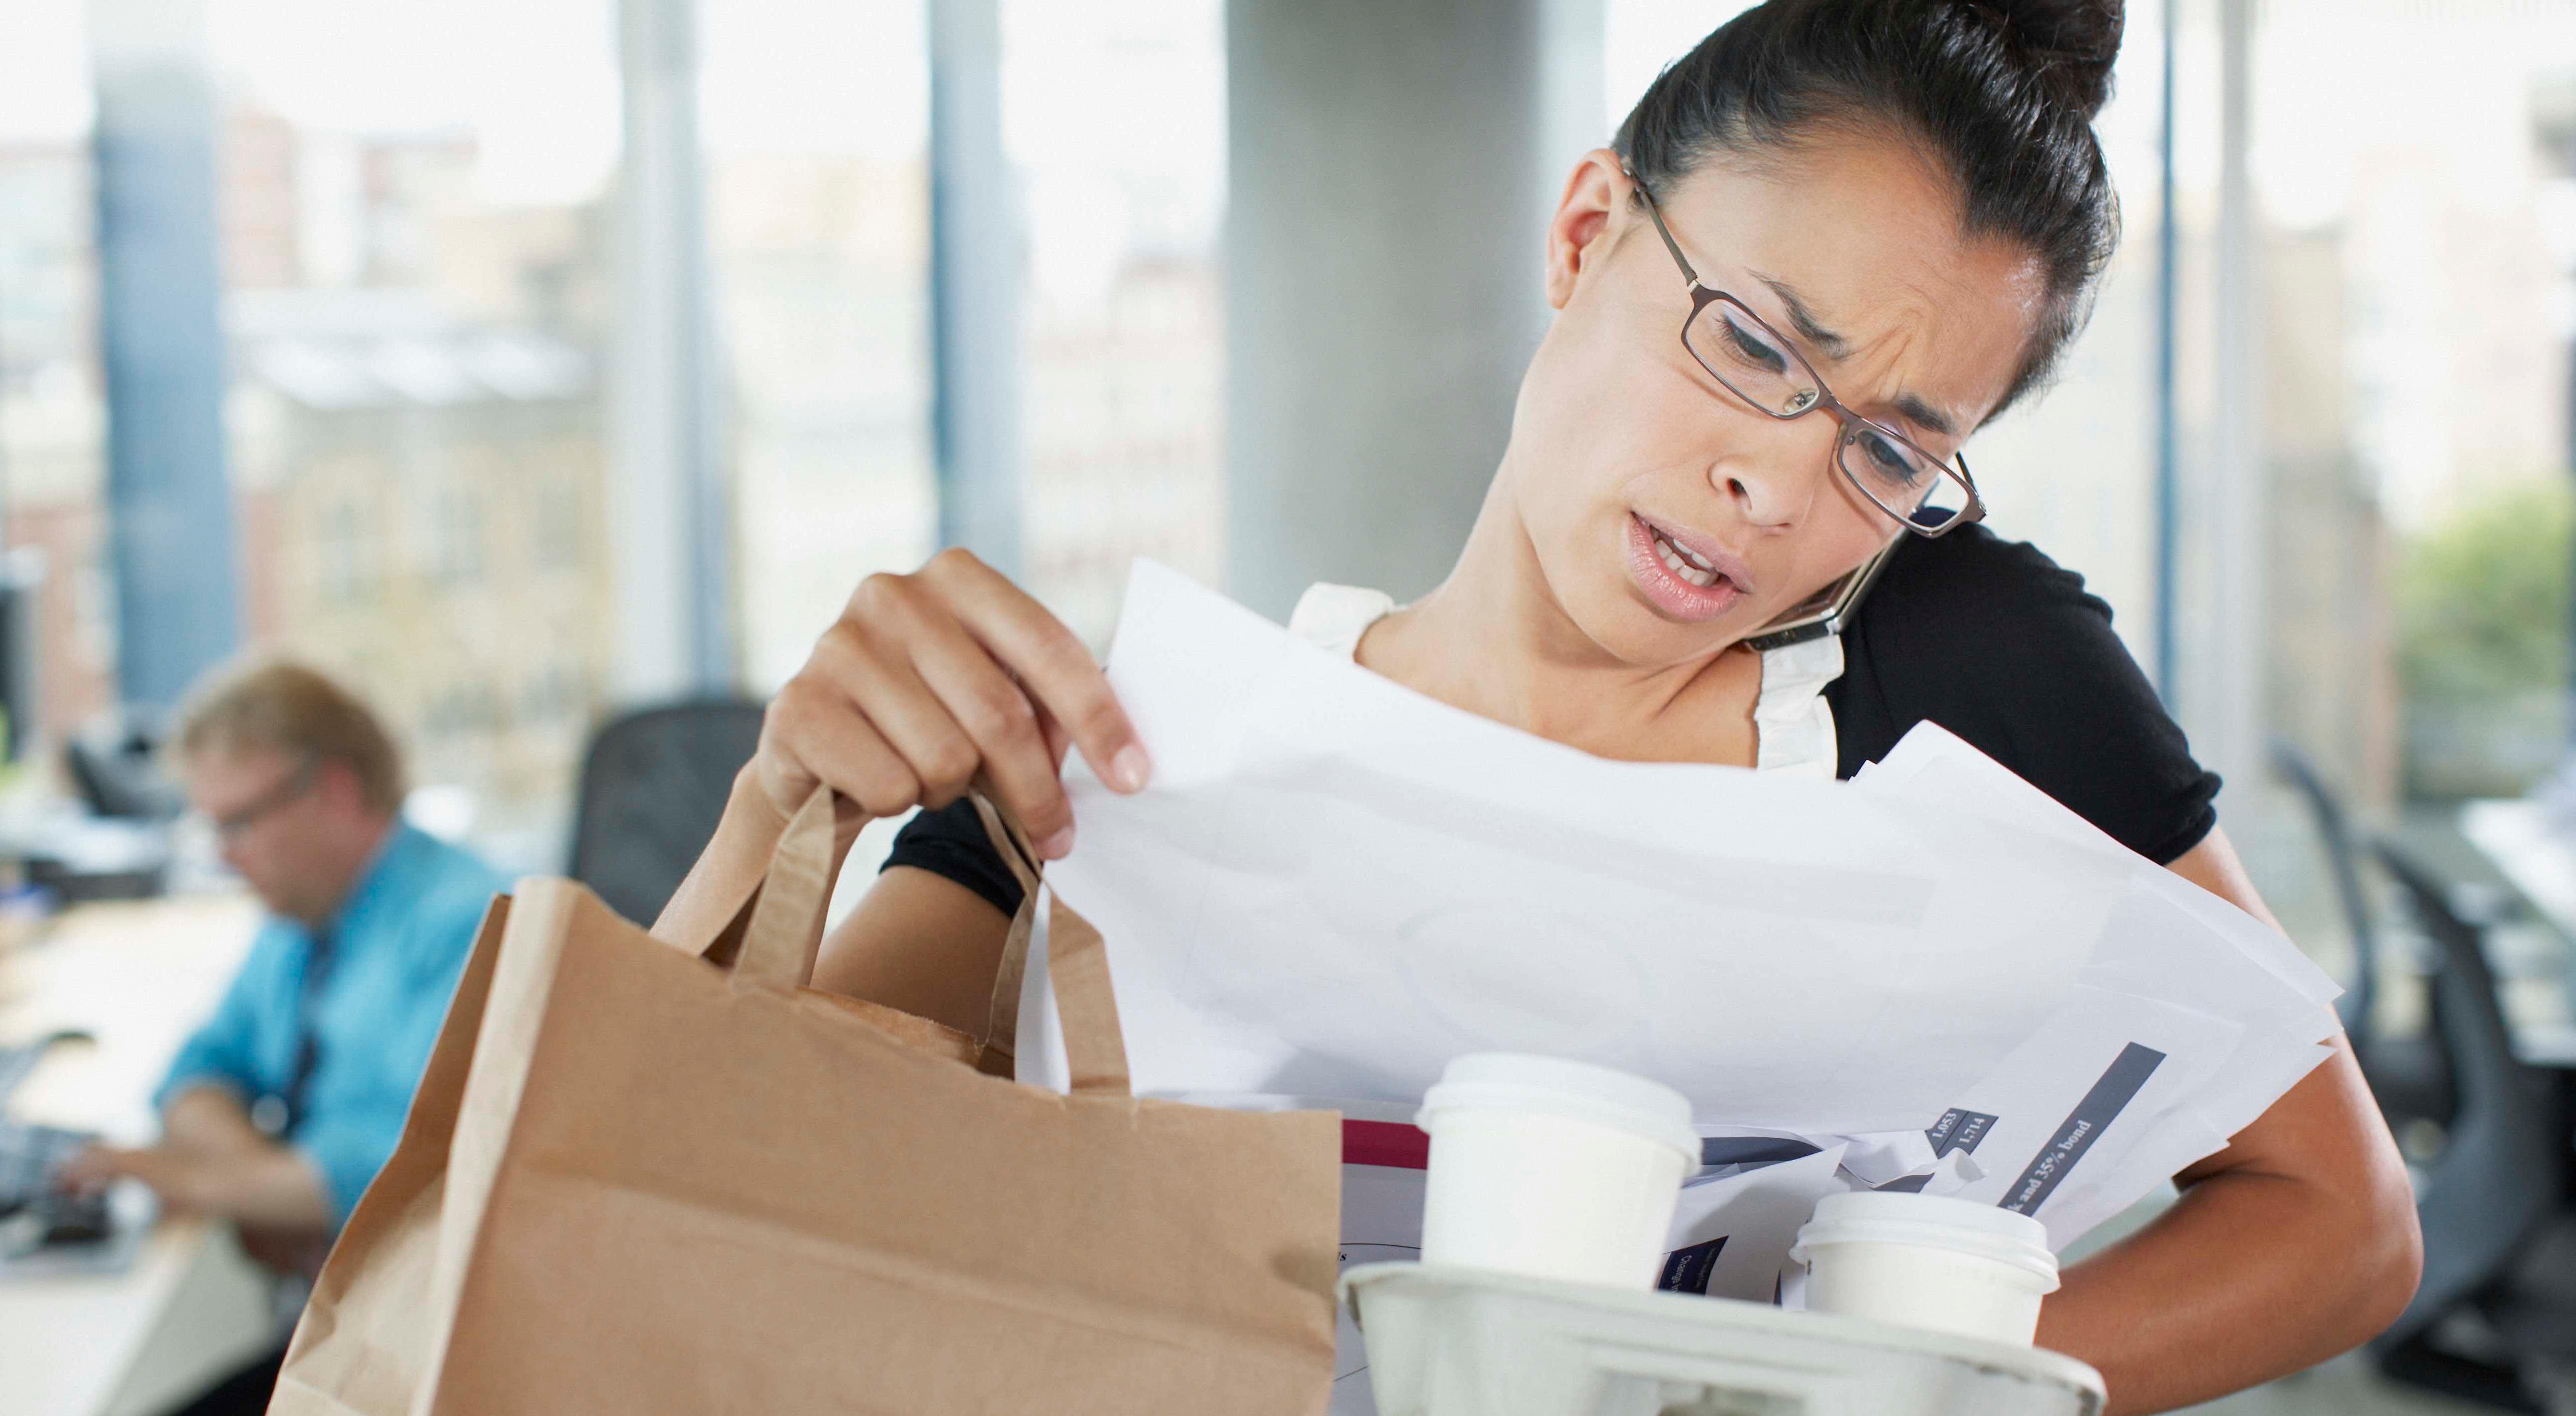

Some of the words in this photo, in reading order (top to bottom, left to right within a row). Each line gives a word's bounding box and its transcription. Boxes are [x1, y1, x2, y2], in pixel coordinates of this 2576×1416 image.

[1932, 1113, 1957, 1138] 1,053
[1959, 1118, 1985, 1143] 1,714
[2020, 1178, 2043, 1202] and
[2034, 1152, 2065, 1179] 35%
[2057, 1120, 2092, 1150] bond
[1671, 1255, 1692, 1284] Change
